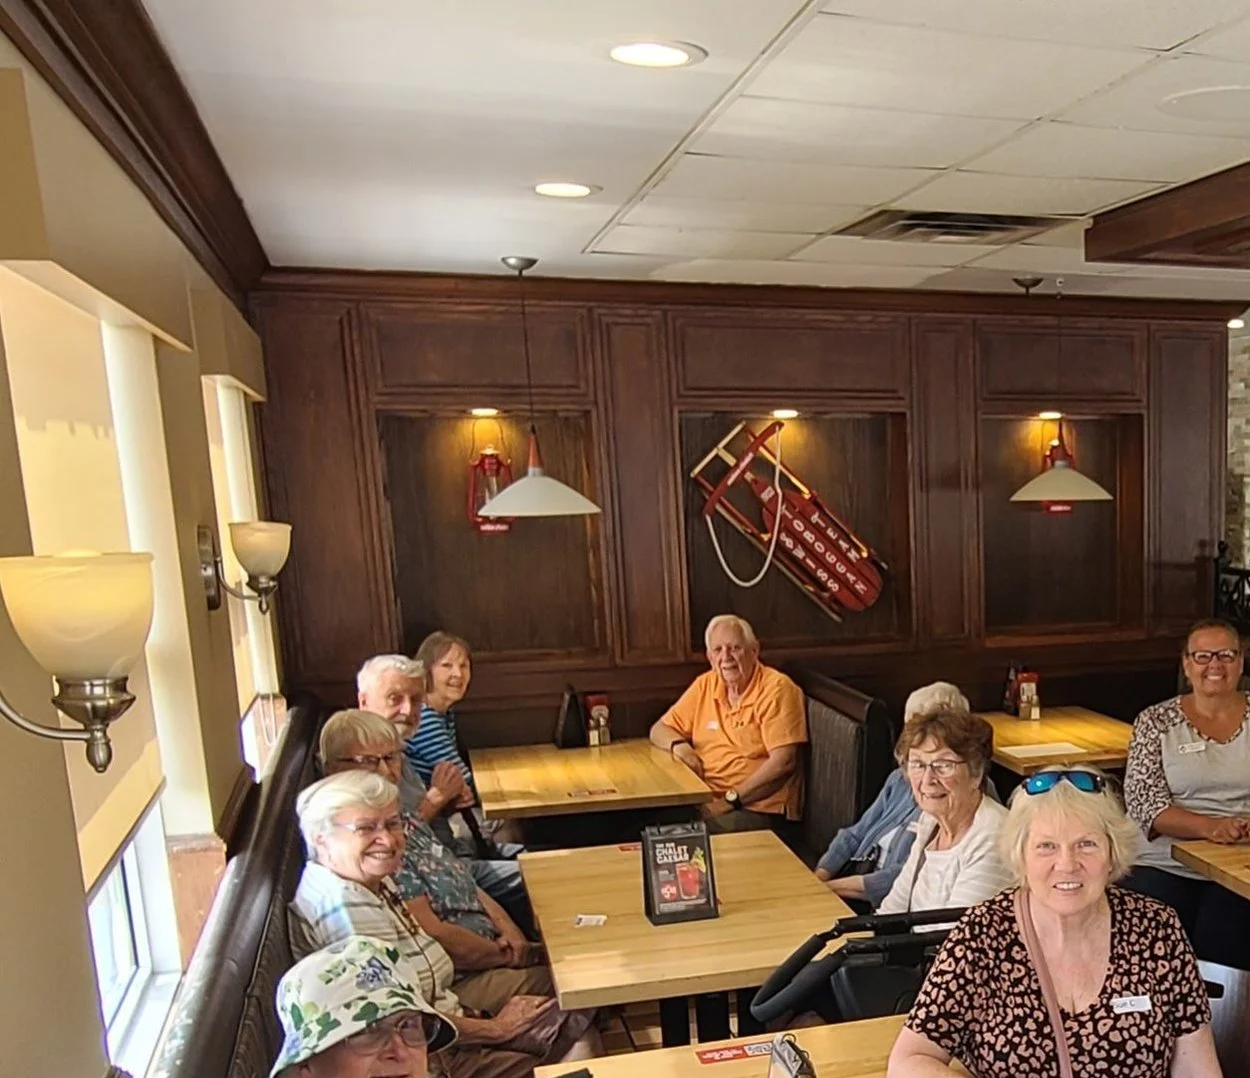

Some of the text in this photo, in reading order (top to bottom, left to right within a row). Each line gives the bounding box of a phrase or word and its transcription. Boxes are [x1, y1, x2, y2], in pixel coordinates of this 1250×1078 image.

[780, 504, 868, 595] TOBOGGAN
[811, 511, 862, 564] TEAM
[656, 846, 688, 857] CHALET
